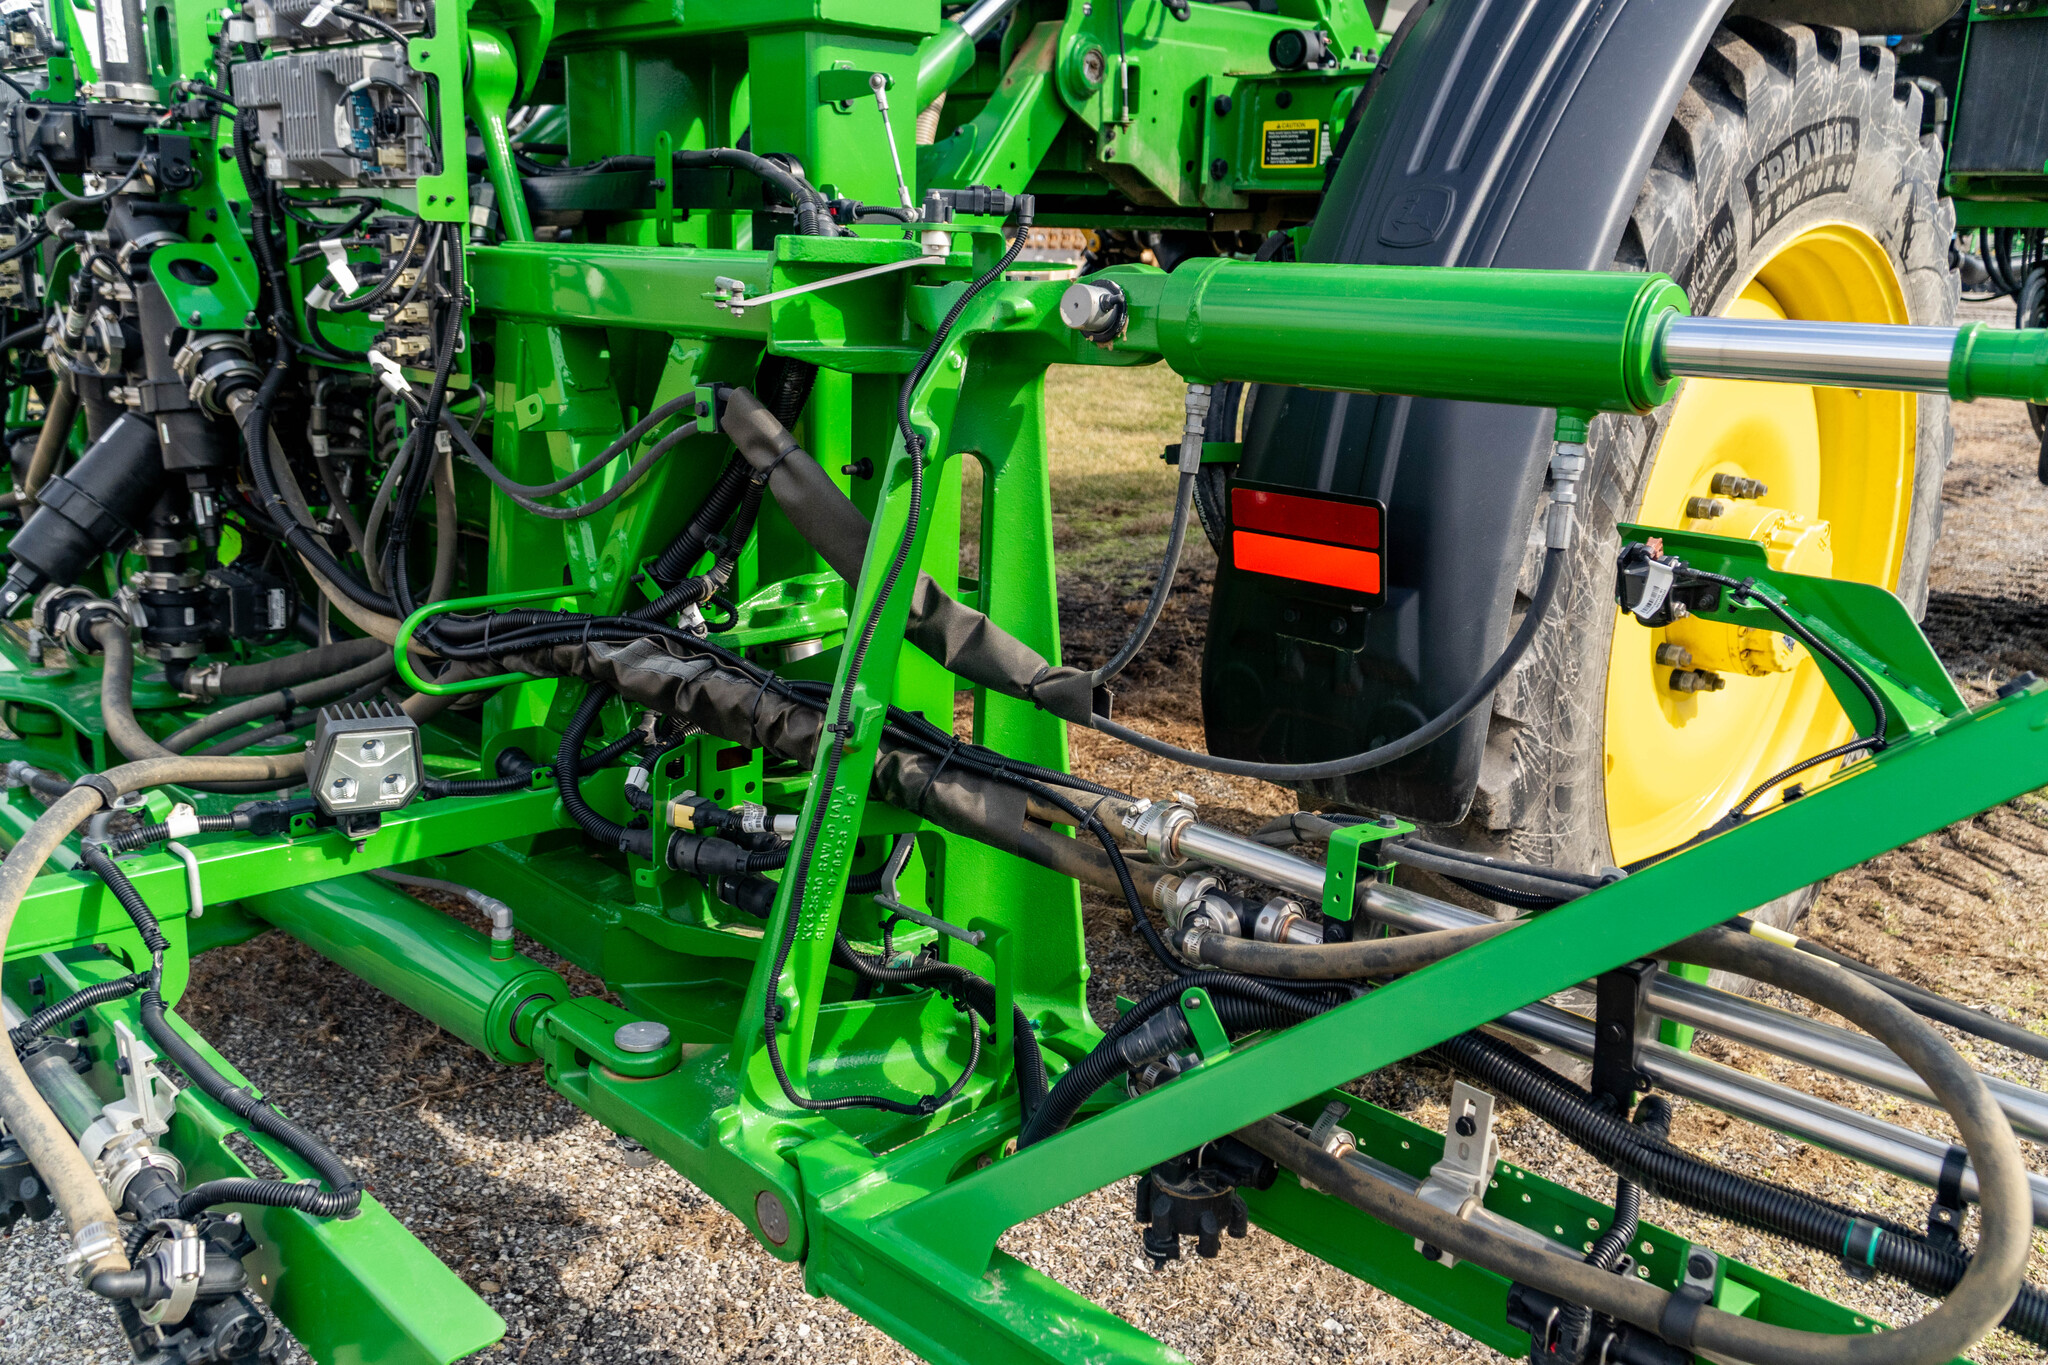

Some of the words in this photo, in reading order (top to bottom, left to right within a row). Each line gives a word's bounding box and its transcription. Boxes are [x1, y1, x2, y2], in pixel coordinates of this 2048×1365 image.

[1755, 203, 1772, 238] VF
[1836, 163, 1853, 187] 46
[1756, 122, 1853, 204] SPRAYBIB
[818, 843, 832, 872] RAW
